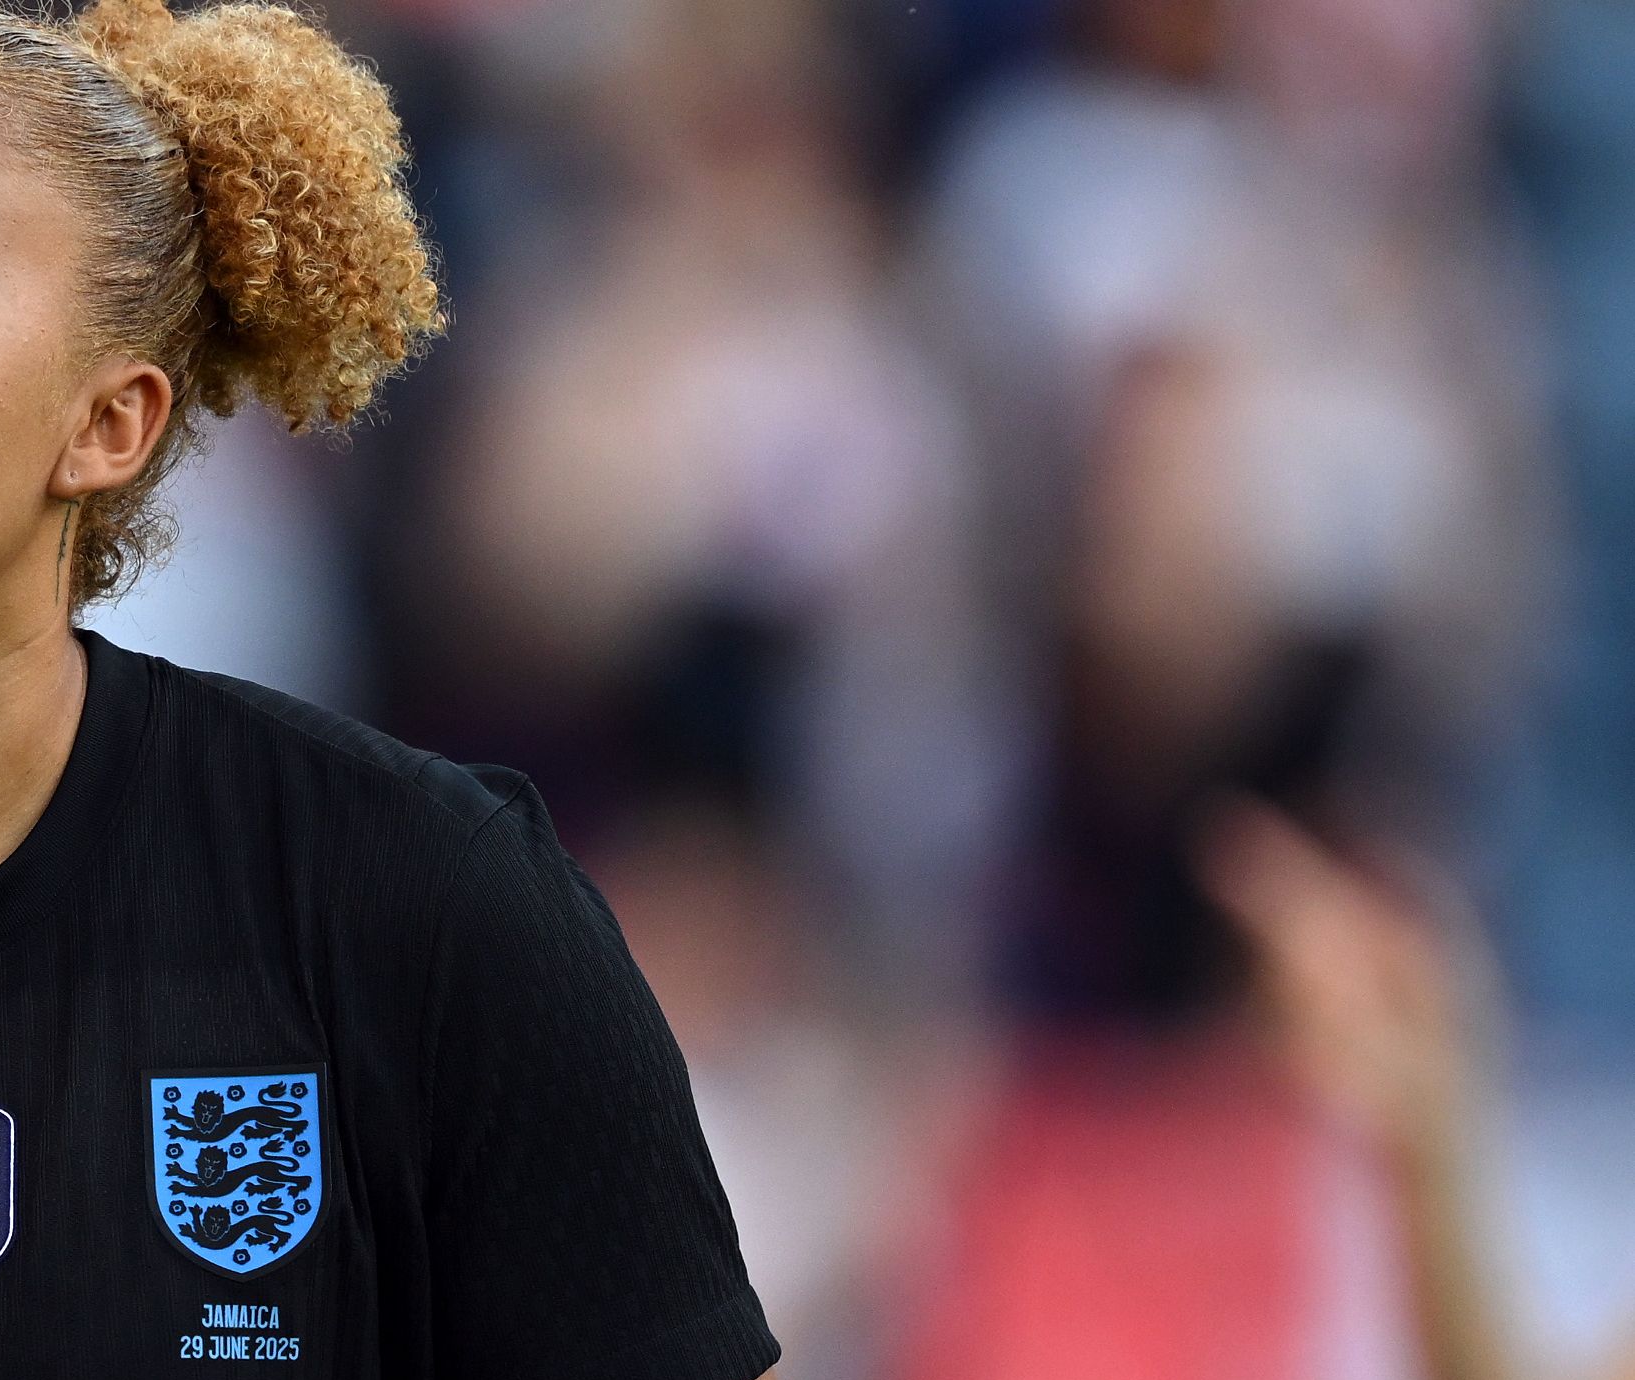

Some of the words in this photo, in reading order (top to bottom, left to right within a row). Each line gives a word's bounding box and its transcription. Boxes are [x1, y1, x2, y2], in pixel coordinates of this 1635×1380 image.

[201, 1304, 280, 1329] JAMAICA
[180, 1335, 203, 1359] 29
[208, 1336, 250, 1360] JUNE
[255, 1337, 300, 1361] 2025
